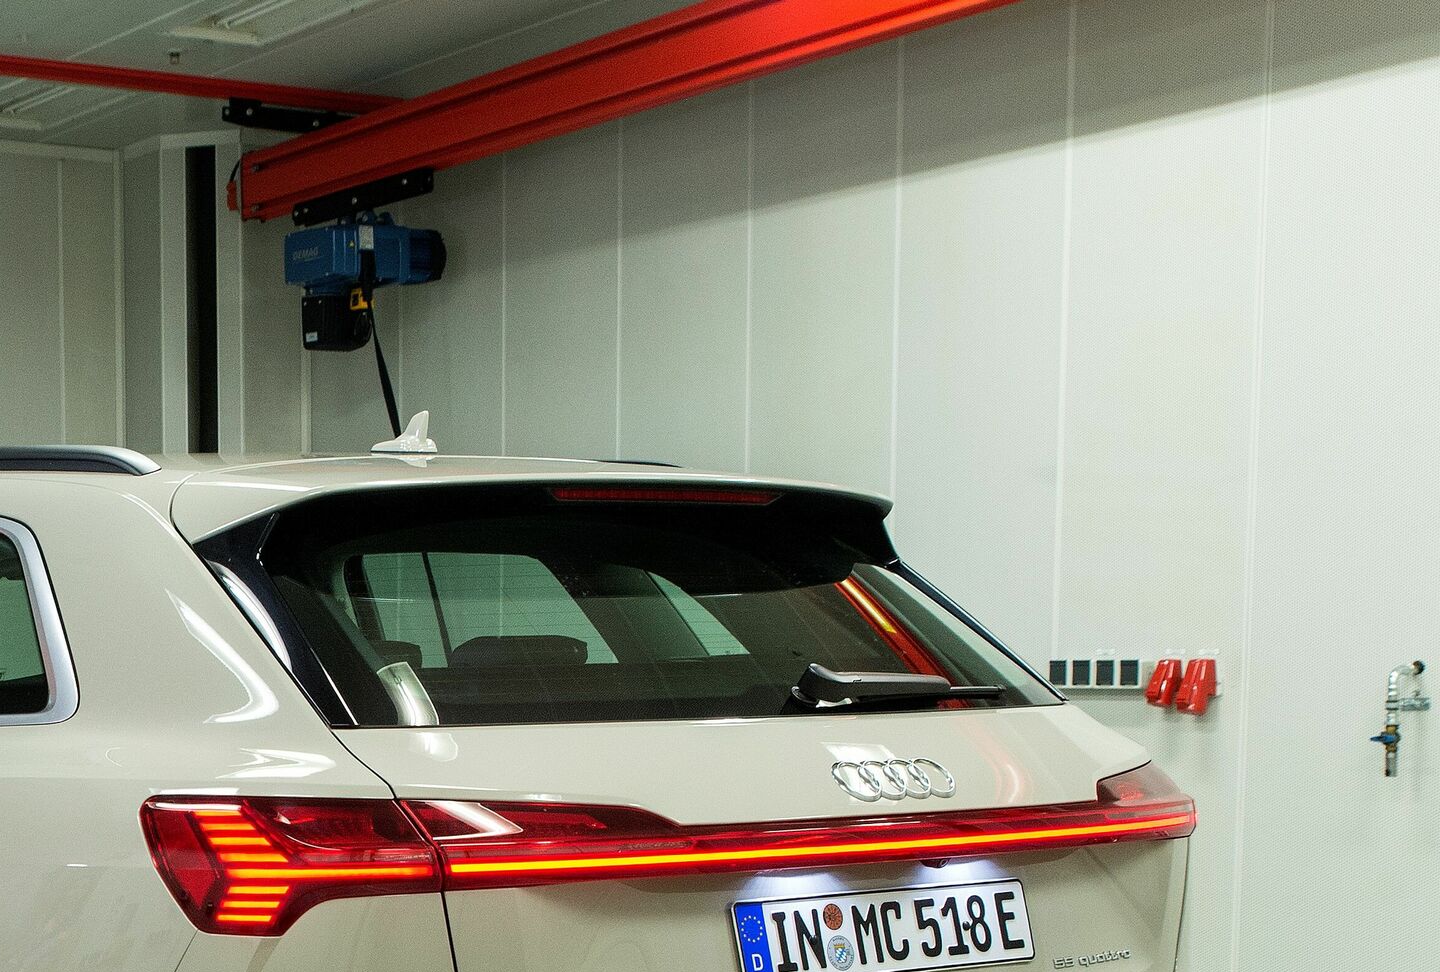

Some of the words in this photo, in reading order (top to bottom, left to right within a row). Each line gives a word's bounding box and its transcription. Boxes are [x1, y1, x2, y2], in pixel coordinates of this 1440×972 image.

[851, 900, 910, 966] MC
[752, 953, 765, 972] D
[1078, 949, 1132, 968] quattro
